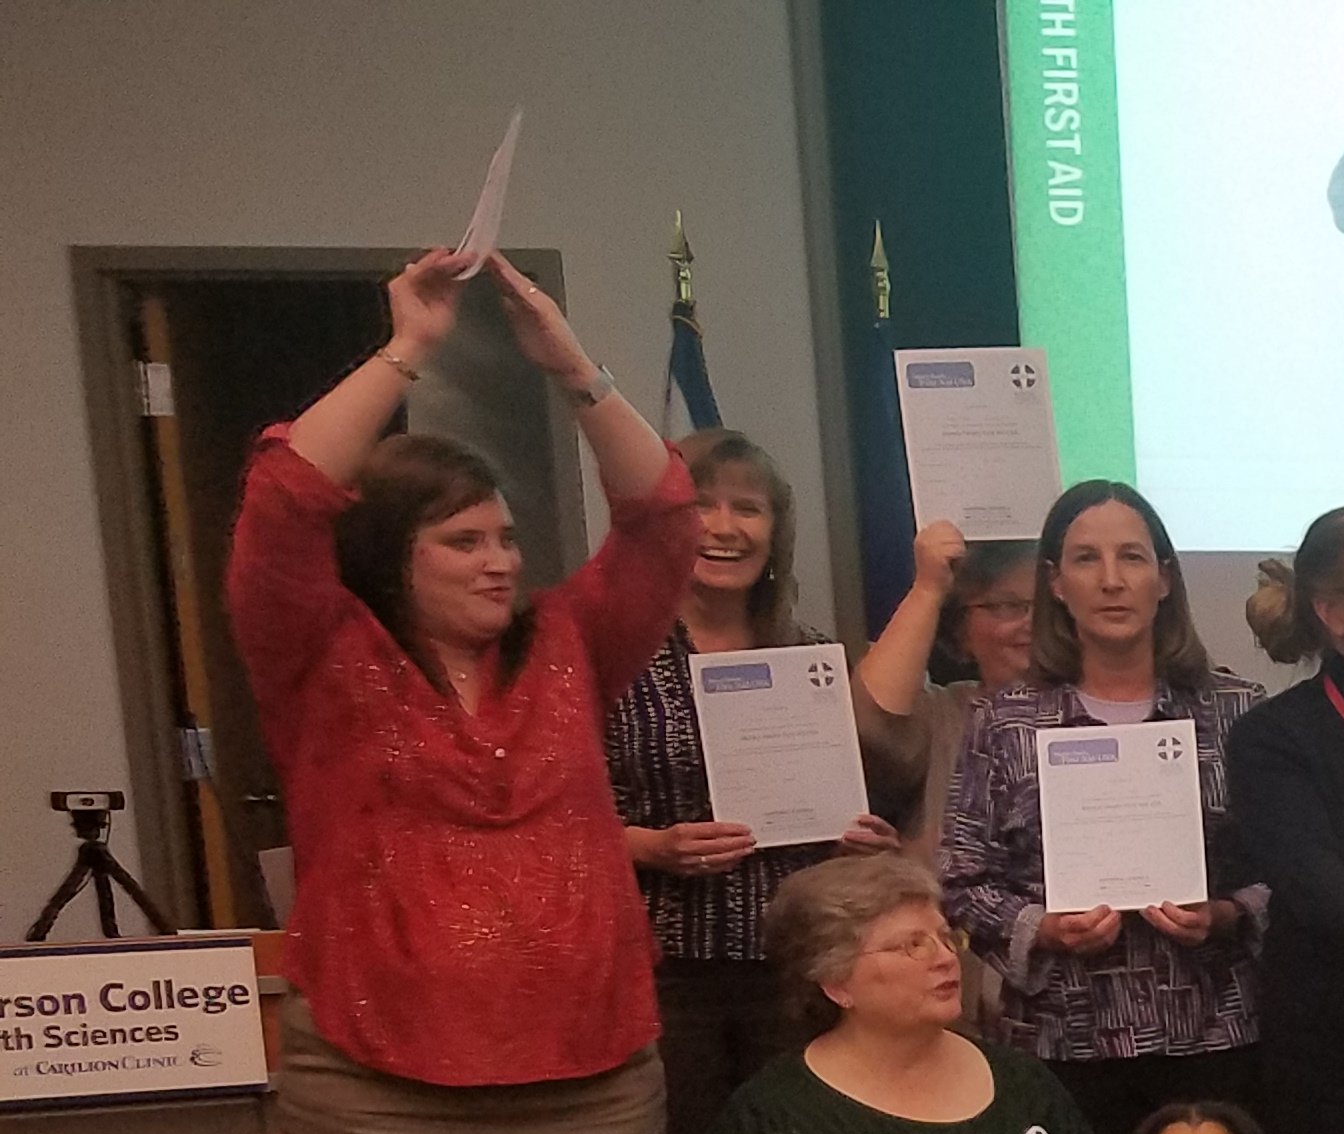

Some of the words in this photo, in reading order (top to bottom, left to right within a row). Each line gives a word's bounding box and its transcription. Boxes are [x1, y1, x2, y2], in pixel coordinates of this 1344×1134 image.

[1042, 48, 1082, 155] FIRST
[1047, 160, 1084, 226] AID
[99, 979, 250, 1014] College
[43, 1023, 179, 1048] Sciences
